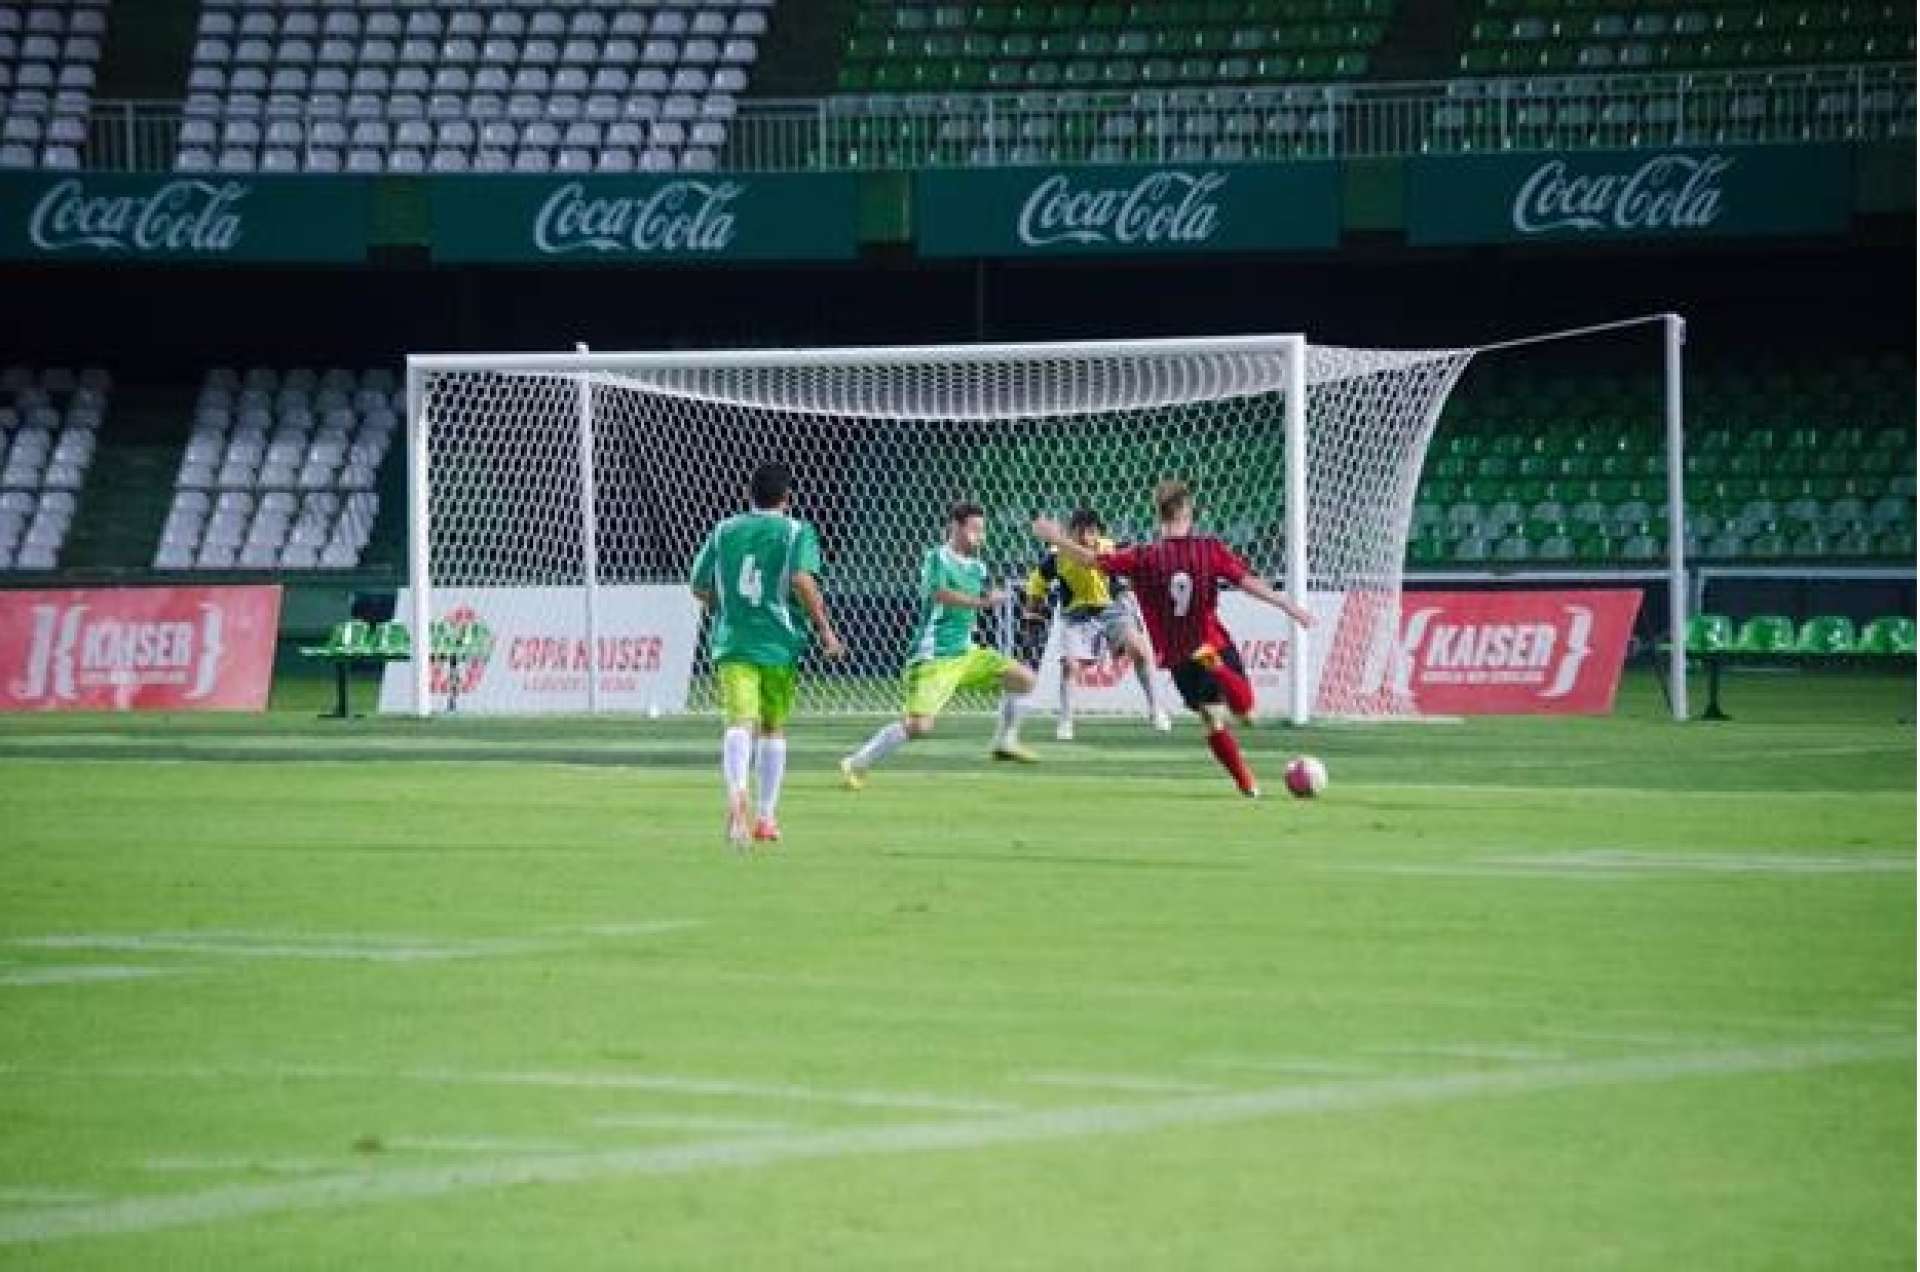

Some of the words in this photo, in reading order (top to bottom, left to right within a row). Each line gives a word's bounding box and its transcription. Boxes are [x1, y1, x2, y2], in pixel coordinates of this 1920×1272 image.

[29, 180, 251, 251] Coca-Cola
[533, 181, 745, 252] Coca-Cola
[1018, 171, 1230, 245] Coca-Cola
[1512, 155, 1736, 232] Coca-Cola
[738, 554, 763, 607] 4
[1169, 571, 1193, 617] 9
[83, 621, 195, 666] KAISER
[1426, 623, 1556, 667] KAISER
